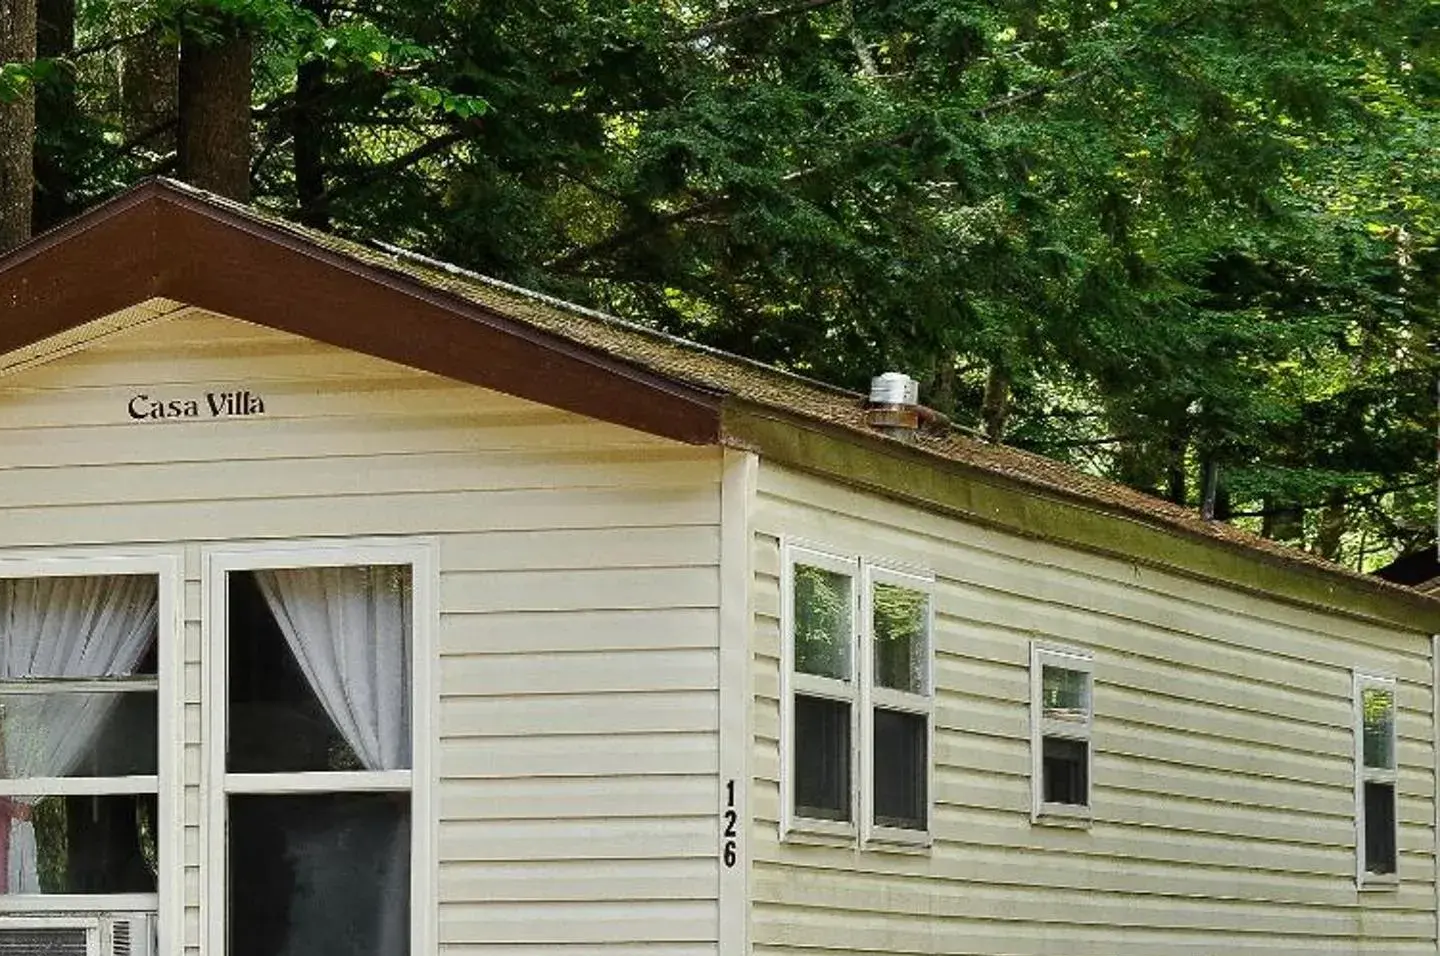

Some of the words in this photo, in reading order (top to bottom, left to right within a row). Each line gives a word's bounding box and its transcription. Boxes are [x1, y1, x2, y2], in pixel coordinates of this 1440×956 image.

[128, 394, 199, 419] Casa
[206, 391, 265, 417] Villa
[723, 779, 737, 868] 126
